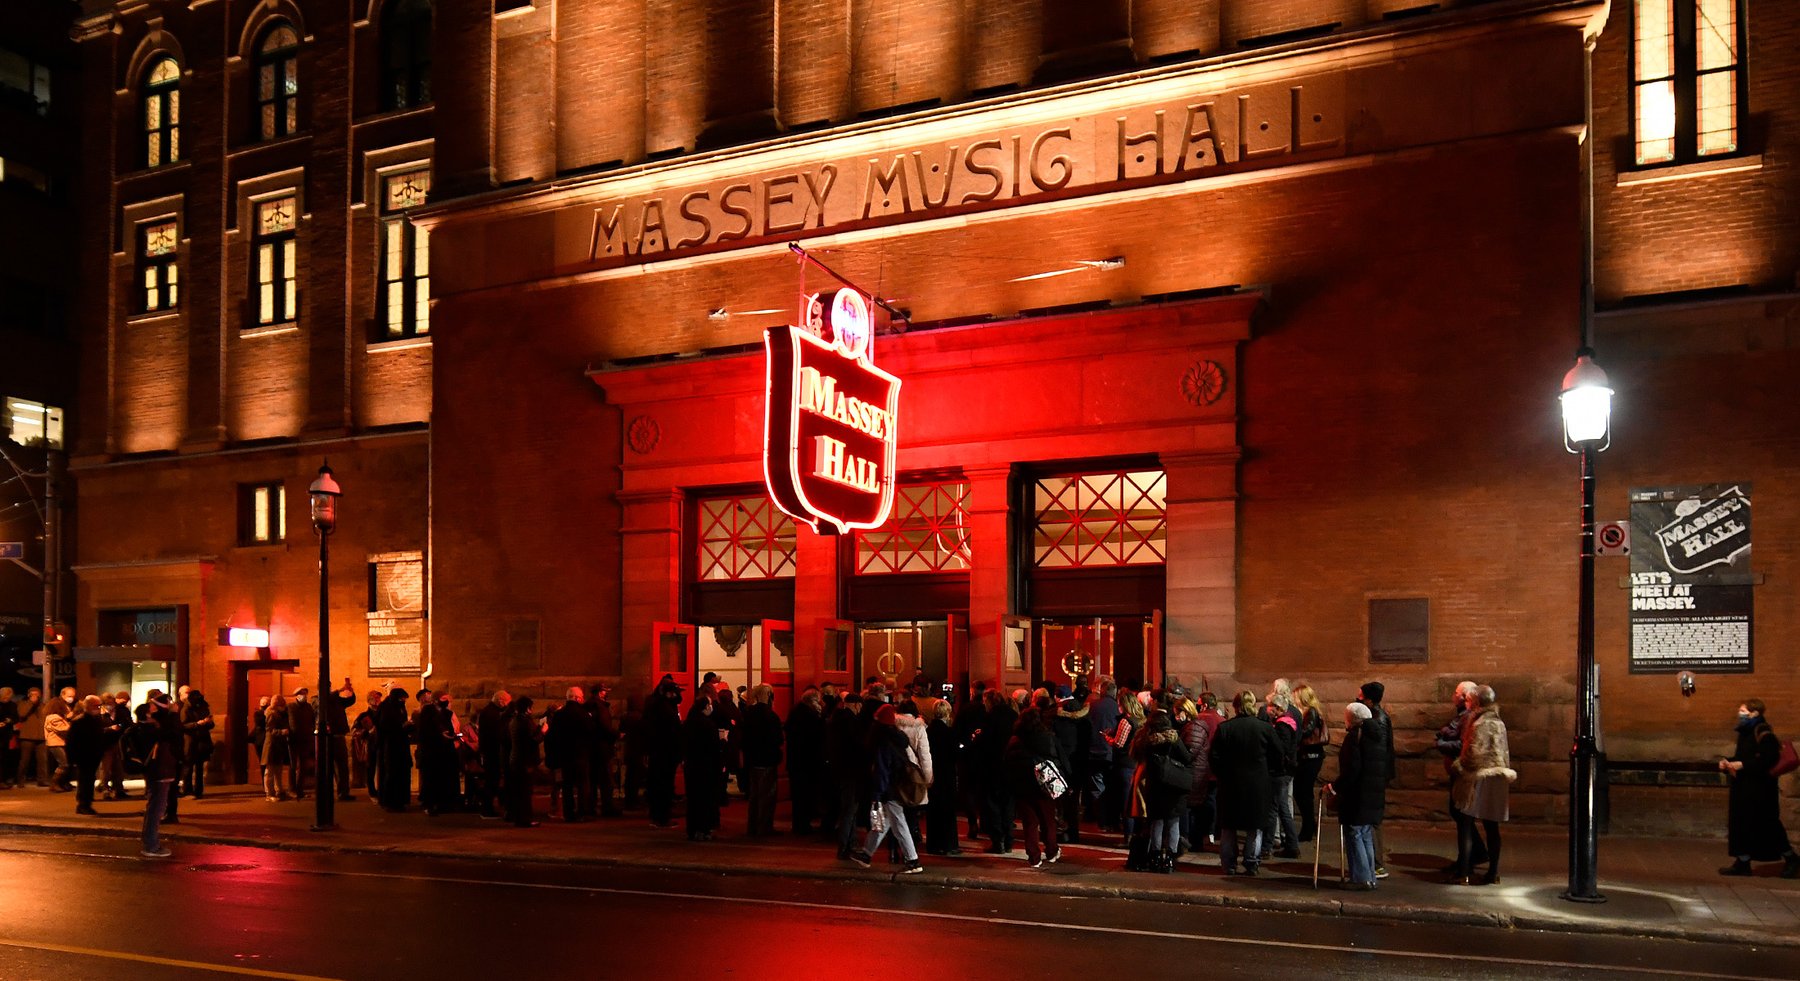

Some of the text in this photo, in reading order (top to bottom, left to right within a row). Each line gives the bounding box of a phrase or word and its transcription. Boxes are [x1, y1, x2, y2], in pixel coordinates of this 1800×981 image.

[589, 85, 1340, 262] MASSEY MUSIC HALL
[801, 366, 895, 443] MASSEY
[813, 434, 880, 495] HALL
[1662, 498, 1742, 547] MASSEY
[1681, 519, 1746, 558] HALL
[1631, 571, 1672, 585] LET'S
[1632, 584, 1692, 597] MEET AT
[1632, 597, 1696, 611] MASSEY.
